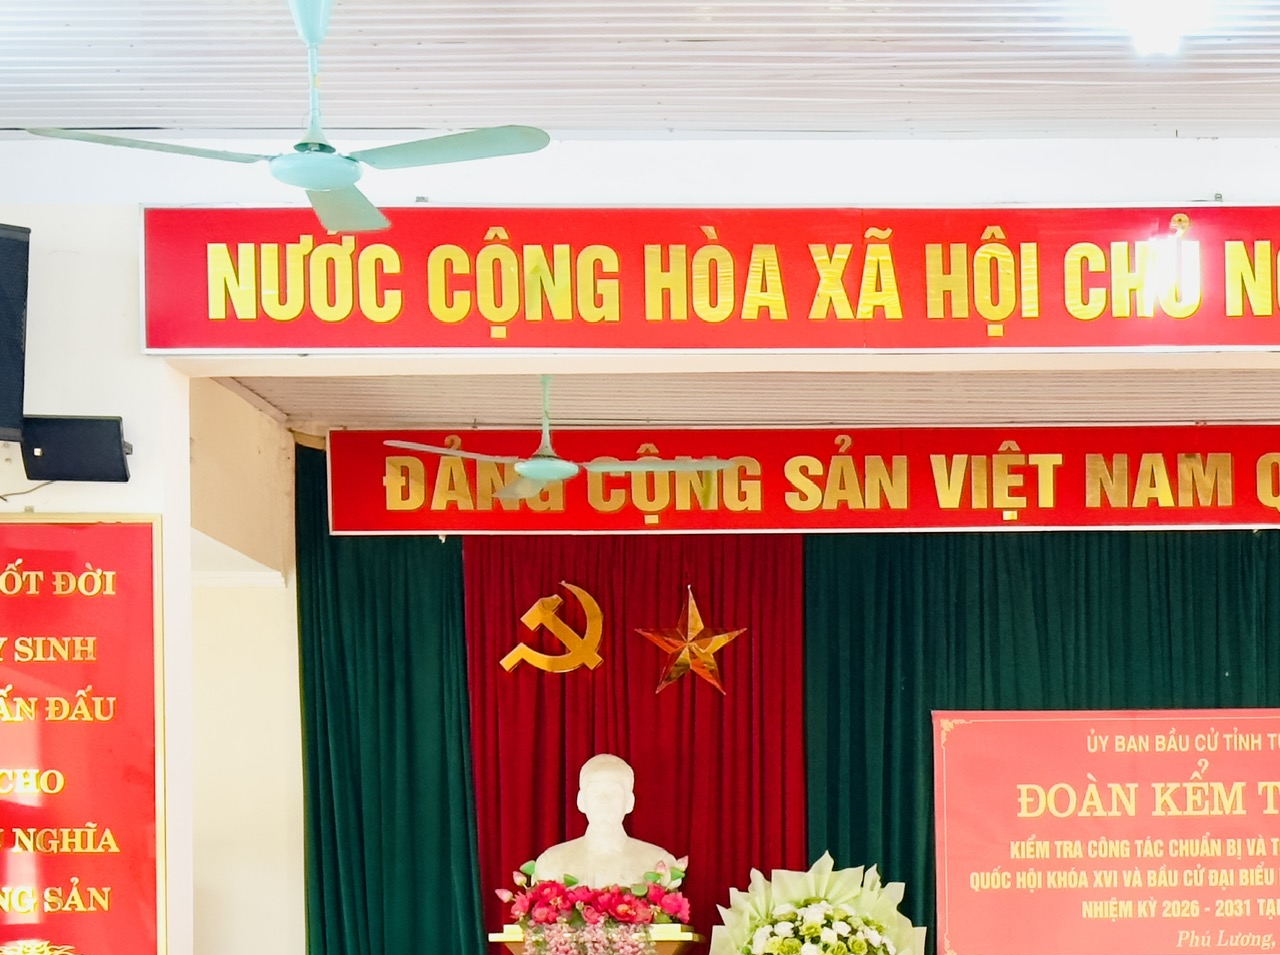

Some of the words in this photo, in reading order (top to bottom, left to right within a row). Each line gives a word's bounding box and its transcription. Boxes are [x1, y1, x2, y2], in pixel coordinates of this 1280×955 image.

[208, 226, 401, 322] NƯỚC
[428, 227, 619, 338] CỘNG
[645, 226, 787, 322] HÒA
[809, 228, 902, 319] XÃ
[926, 226, 1039, 336] HỘI
[1064, 213, 1201, 320] CHỦ
[383, 435, 565, 512] ĐẢNG
[587, 443, 762, 524] CỘNG
[784, 435, 907, 511] SẢN
[930, 441, 1062, 520] VIỆT
[1086, 453, 1232, 507] NAM
[53, 563, 116, 596] ĐỜI
[15, 637, 96, 661] SINH
[46, 685, 116, 721] ĐẤU
[1088, 729, 1108, 752] ỦY
[1115, 736, 1149, 752] BAN
[1156, 728, 1189, 751] BẦU
[1195, 728, 1219, 751] CỬ
[1223, 728, 1261, 750] TỈNH
[0, 769, 64, 794] CHO
[1017, 773, 1138, 817] ĐOÀN
[1152, 759, 1246, 816] KỂM
[9, 822, 120, 857] NGHĨA
[1011, 835, 1049, 858] KIỂM
[1055, 841, 1083, 858] TRA
[1088, 837, 1130, 858] CÔNG
[1135, 837, 1163, 857] TÁC
[1169, 832, 1221, 857] CHUẨN
[1227, 839, 1241, 860] BỊ
[1247, 835, 1266, 856] VÀ
[970, 866, 1011, 891] QUỐC
[1017, 868, 1042, 892] HỘI
[1047, 868, 1088, 888] KHÓA
[1094, 871, 1117, 887] XVI
[1123, 867, 1142, 887] VÀ
[1148, 865, 1178, 887] BẦU
[1184, 864, 1205, 886] CỬ
[1208, 869, 1234, 890] ĐẠI
[1239, 862, 1274, 886] BIỂU
[44, 877, 110, 912] SẢN
[1082, 897, 1133, 921] NHIỆM
[1138, 897, 1157, 917] KỲ
[1163, 900, 1199, 917] 2026
[1216, 899, 1250, 916] 2031
[1257, 899, 1280, 919] TẠI
[1177, 930, 1210, 947] Phú
[1217, 930, 1275, 949] Lương,
